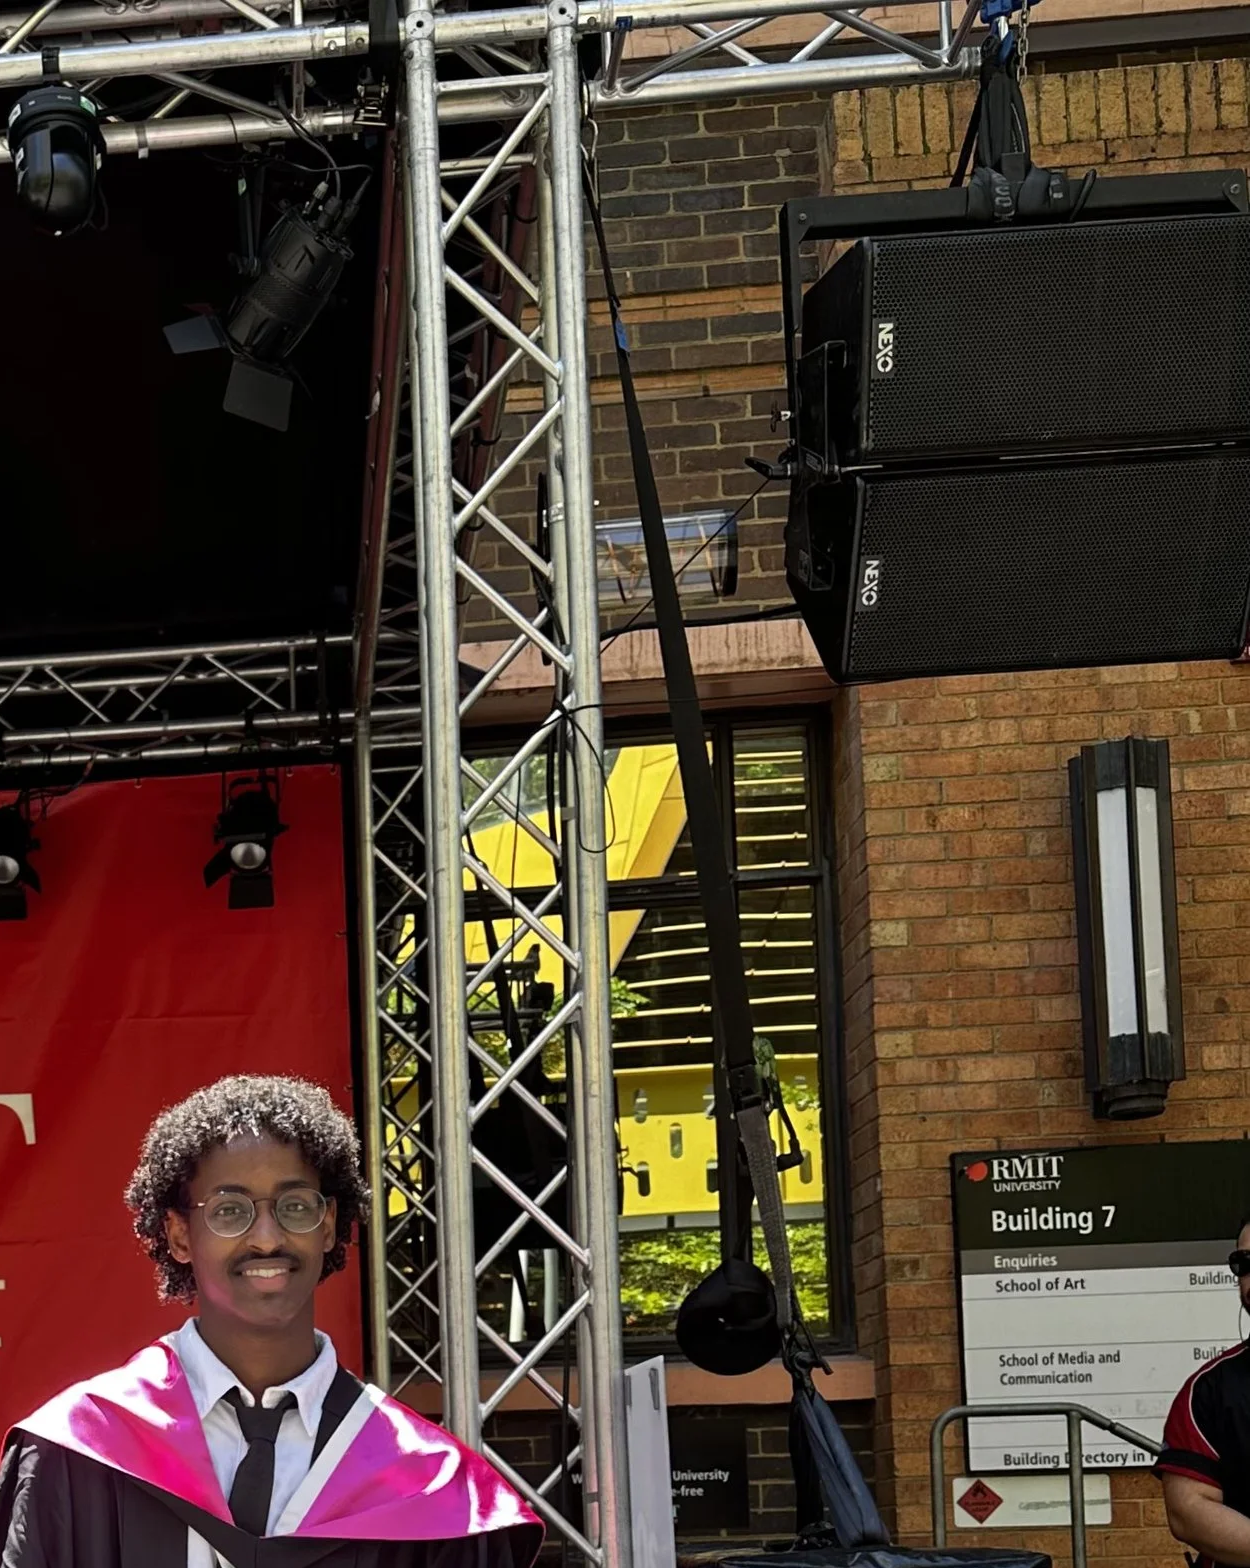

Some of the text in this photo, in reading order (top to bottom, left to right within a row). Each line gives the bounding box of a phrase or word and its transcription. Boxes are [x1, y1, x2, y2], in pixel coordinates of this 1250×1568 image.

[875, 322, 894, 372] NEXO
[860, 560, 880, 606] NEXO
[991, 1155, 1064, 1180] RMIT
[993, 1180, 1061, 1192] UNIVERSITY
[991, 1205, 1116, 1234] Building 7
[994, 1253, 1058, 1270] Enquiries
[995, 1277, 1086, 1293] School of Art
[999, 1350, 1121, 1367] School of Media and
[999, 1370, 1093, 1386] Communication
[1003, 1452, 1060, 1468] Building
[1132, 1449, 1146, 1463] in
[672, 1468, 730, 1483] University
[672, 1485, 705, 1497] e-free
